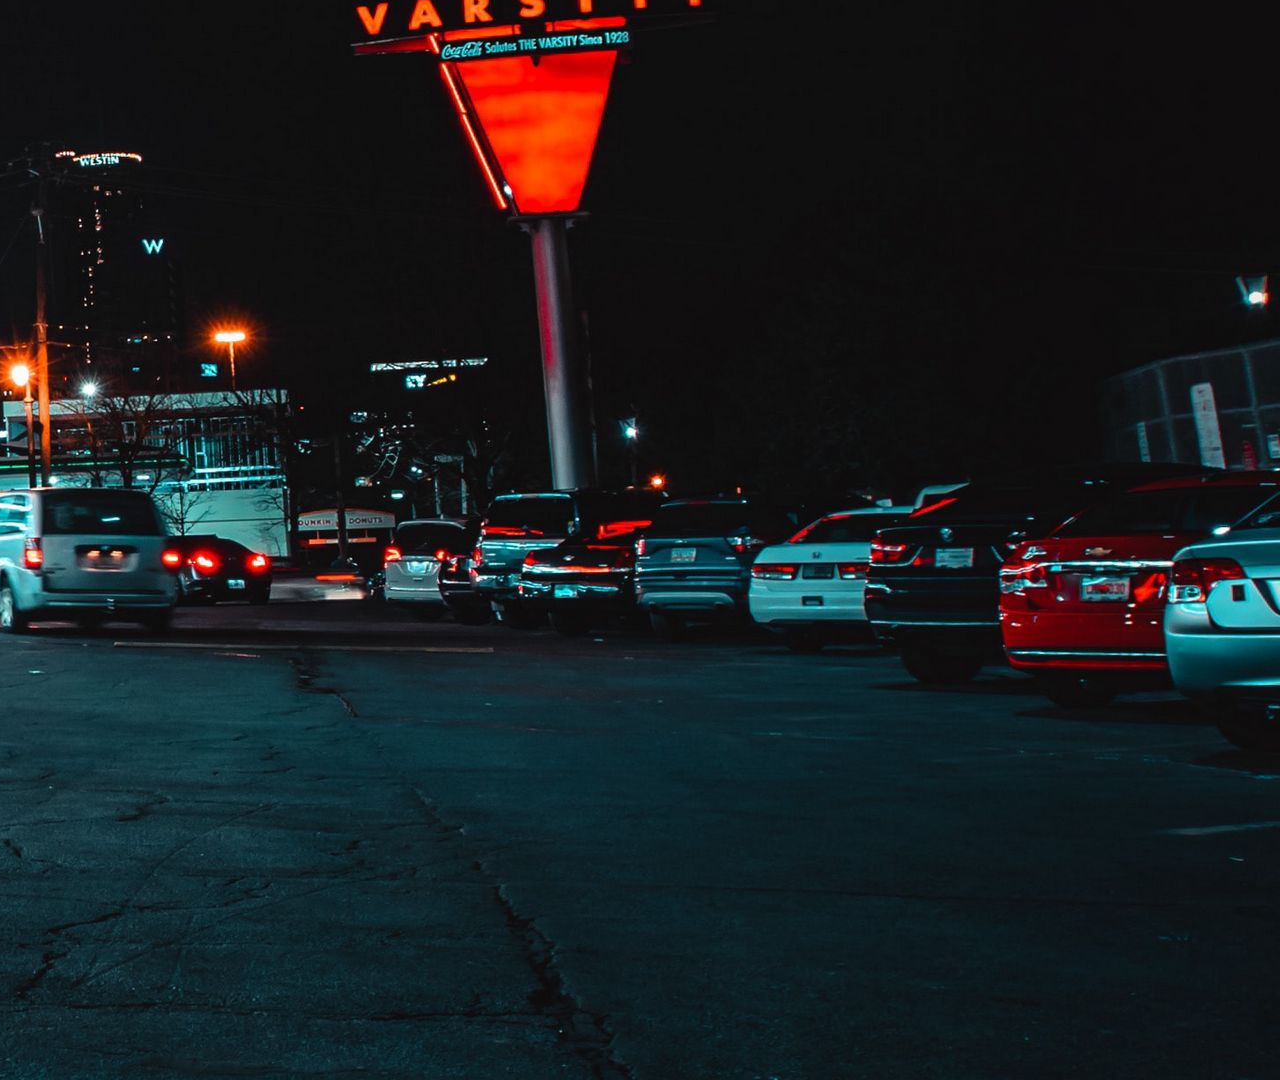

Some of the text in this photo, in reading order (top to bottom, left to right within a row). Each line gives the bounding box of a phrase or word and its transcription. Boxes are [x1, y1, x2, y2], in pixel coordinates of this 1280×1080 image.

[485, 41, 518, 54] Salutes
[518, 38, 537, 51] THE
[538, 35, 578, 49] VARSITY
[578, 33, 603, 46] Since
[604, 31, 630, 44] 1928
[79, 156, 120, 167] WESTIN
[142, 238, 164, 255] W
[348, 517, 383, 525] DONUTS
